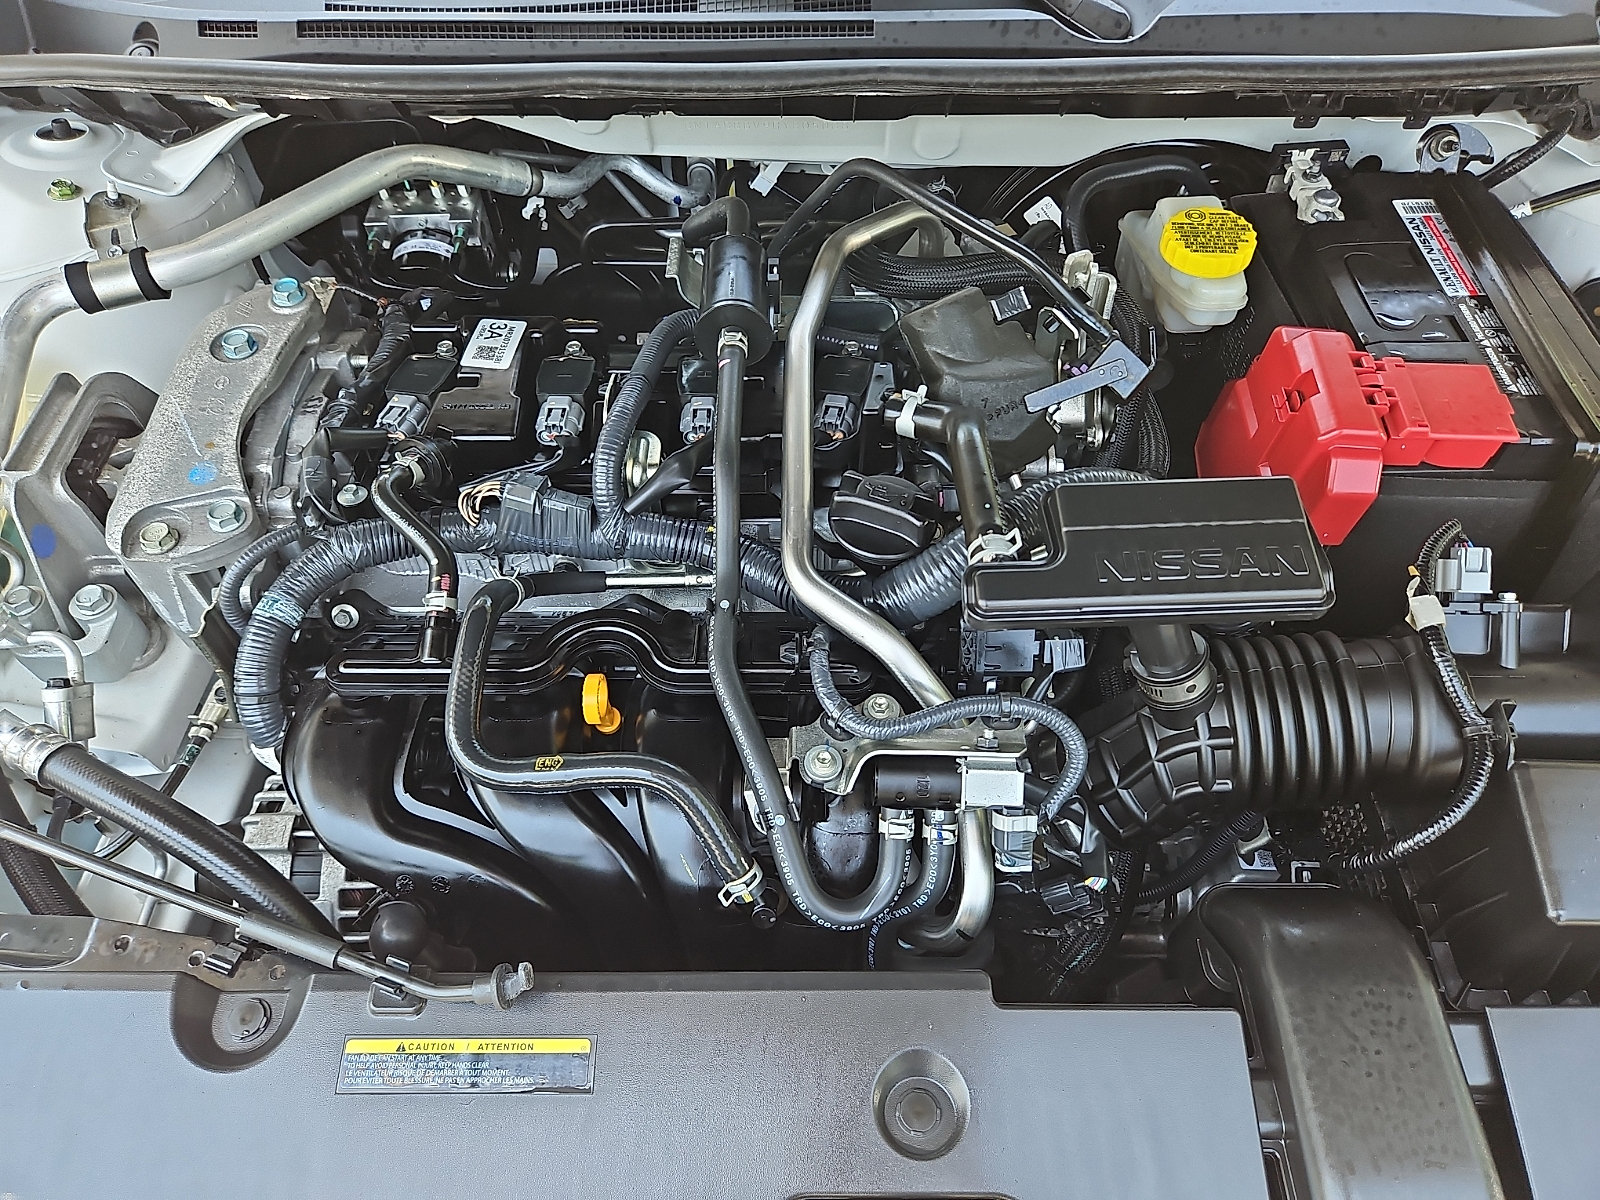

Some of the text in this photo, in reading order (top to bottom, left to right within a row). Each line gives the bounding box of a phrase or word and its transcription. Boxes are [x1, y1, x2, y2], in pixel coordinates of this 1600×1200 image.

[1405, 217, 1437, 255] NISSAN
[484, 322, 508, 340] 3A
[1096, 545, 1310, 582] NISSAN
[538, 758, 559, 767] ENG
[408, 1042, 455, 1051] CAUTION
[477, 1042, 534, 1051] ATTENTION
